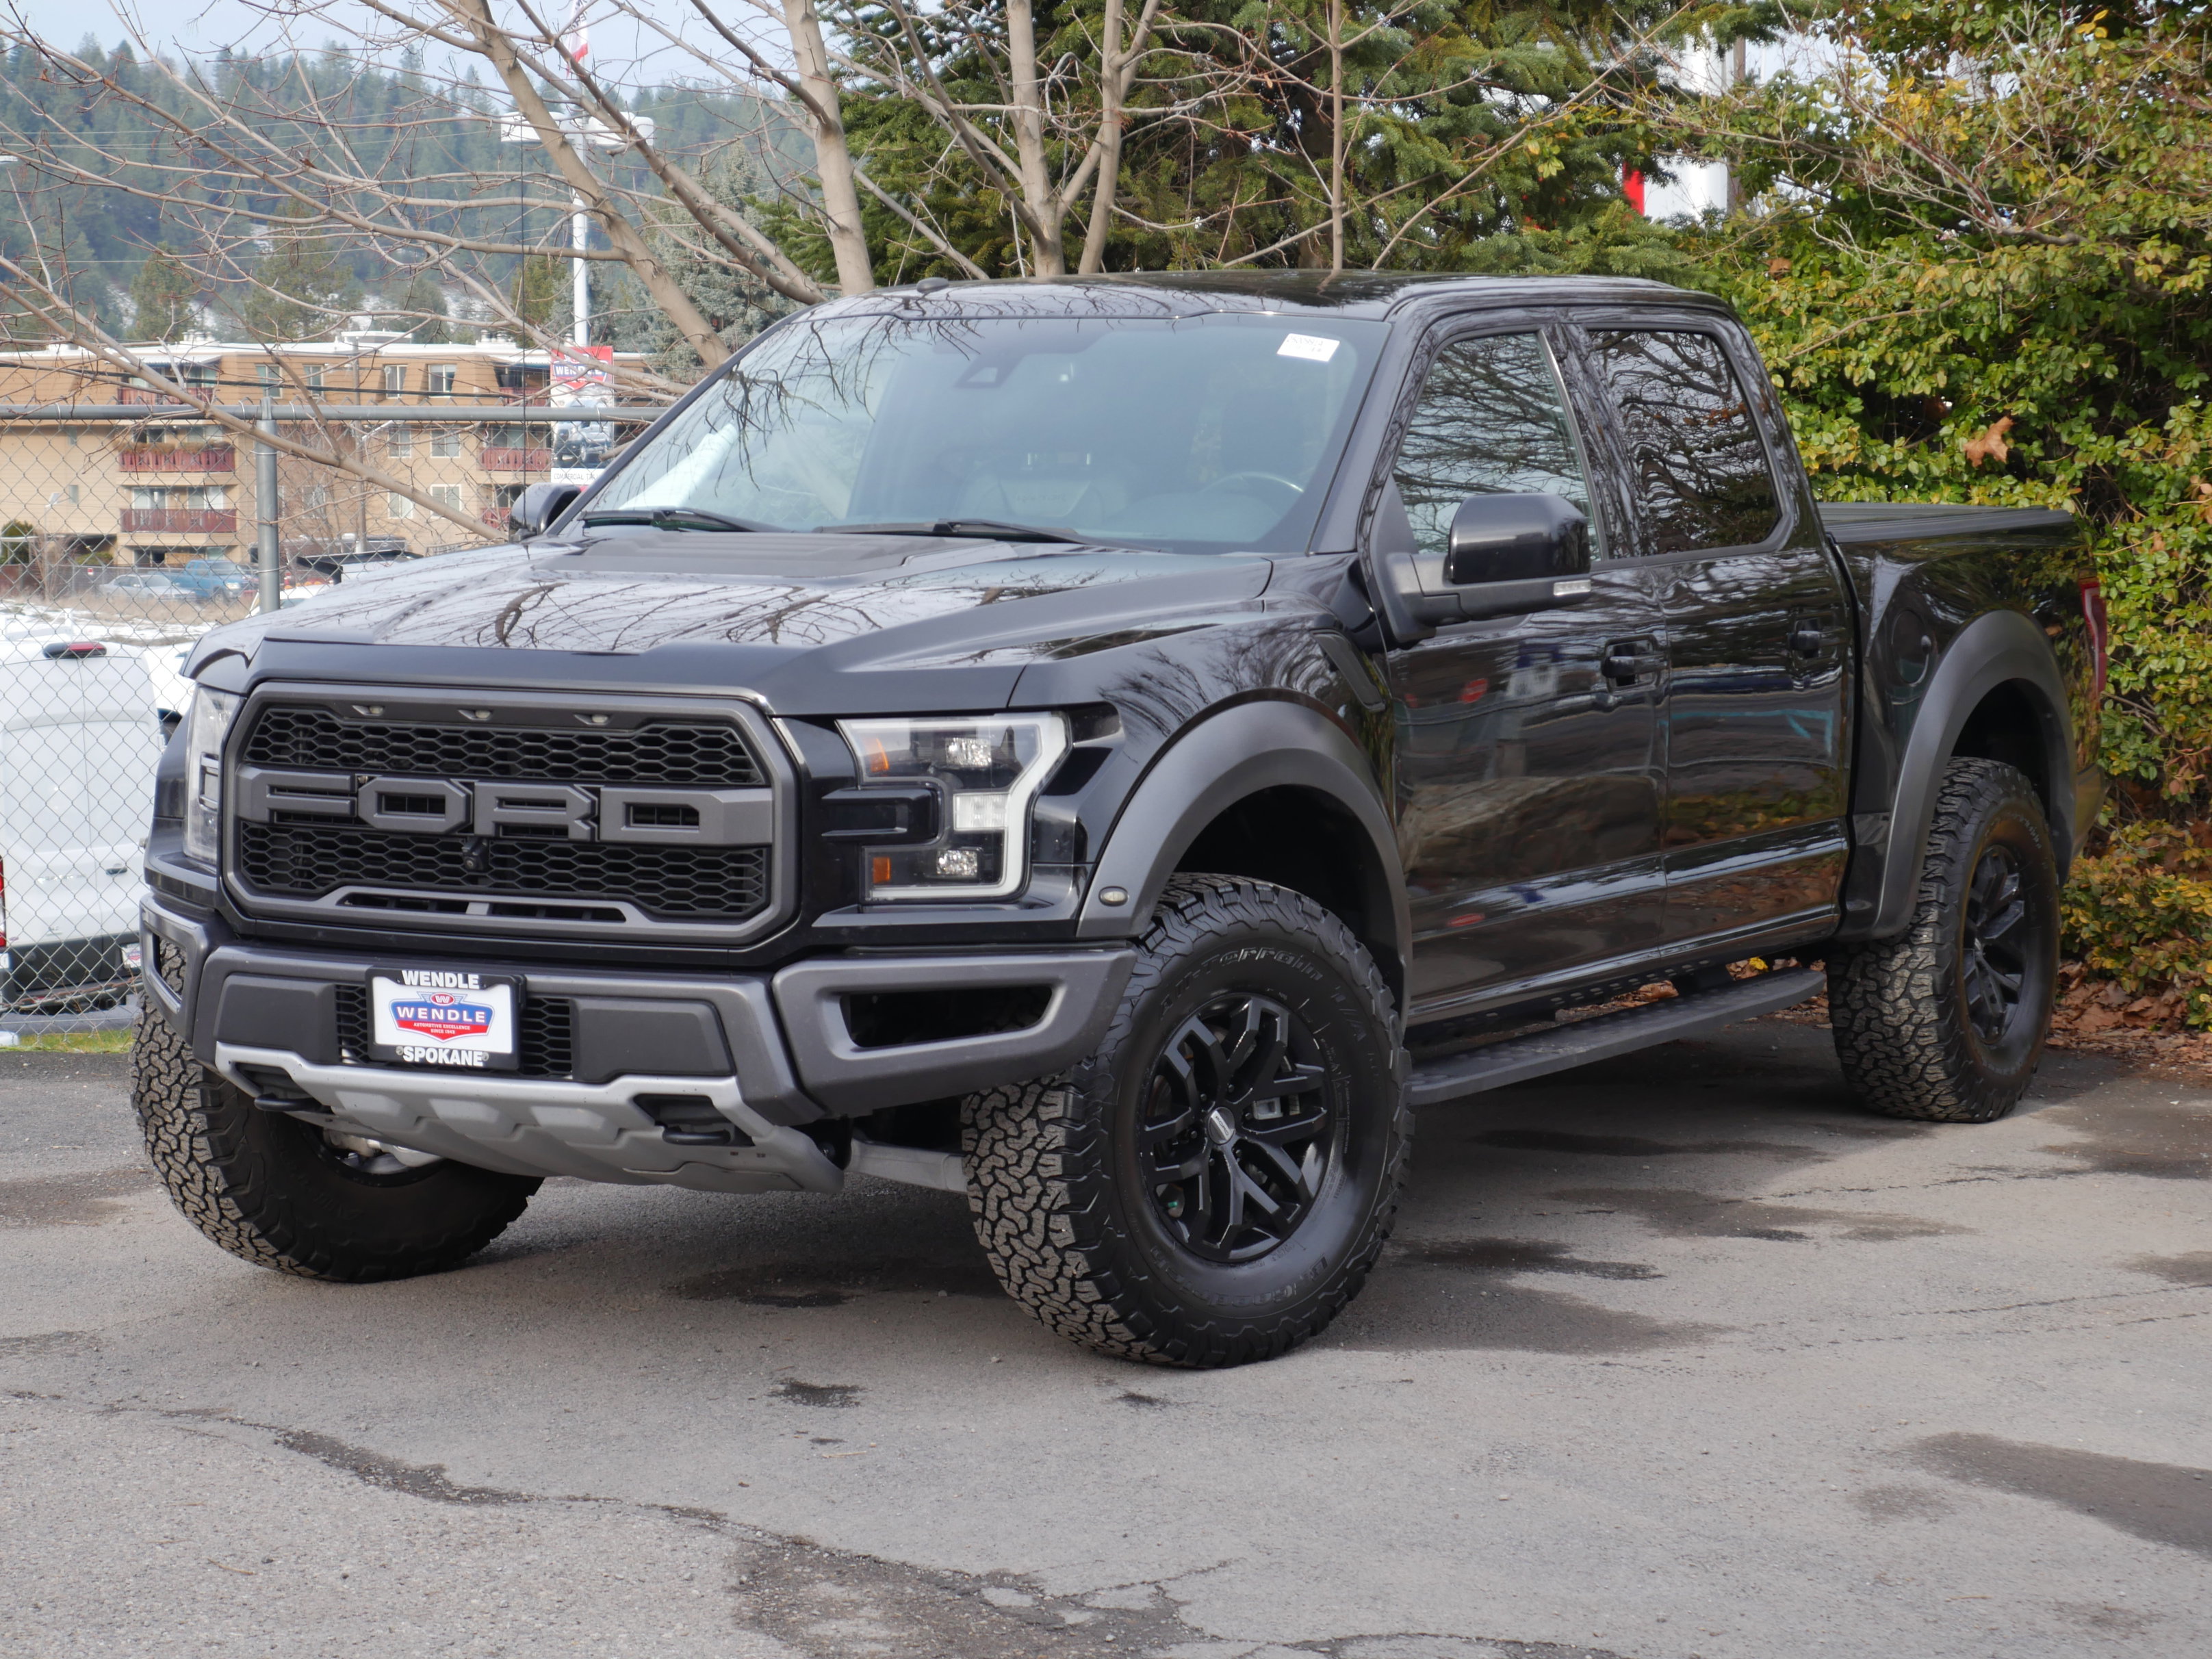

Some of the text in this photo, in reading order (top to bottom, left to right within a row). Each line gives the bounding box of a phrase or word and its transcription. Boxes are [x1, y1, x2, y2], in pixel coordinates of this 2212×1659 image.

[237, 764, 773, 845] FORD
[401, 970, 480, 990] WENDLE
[396, 1006, 485, 1023] WENDLE
[402, 1046, 484, 1067] SPOKANE
